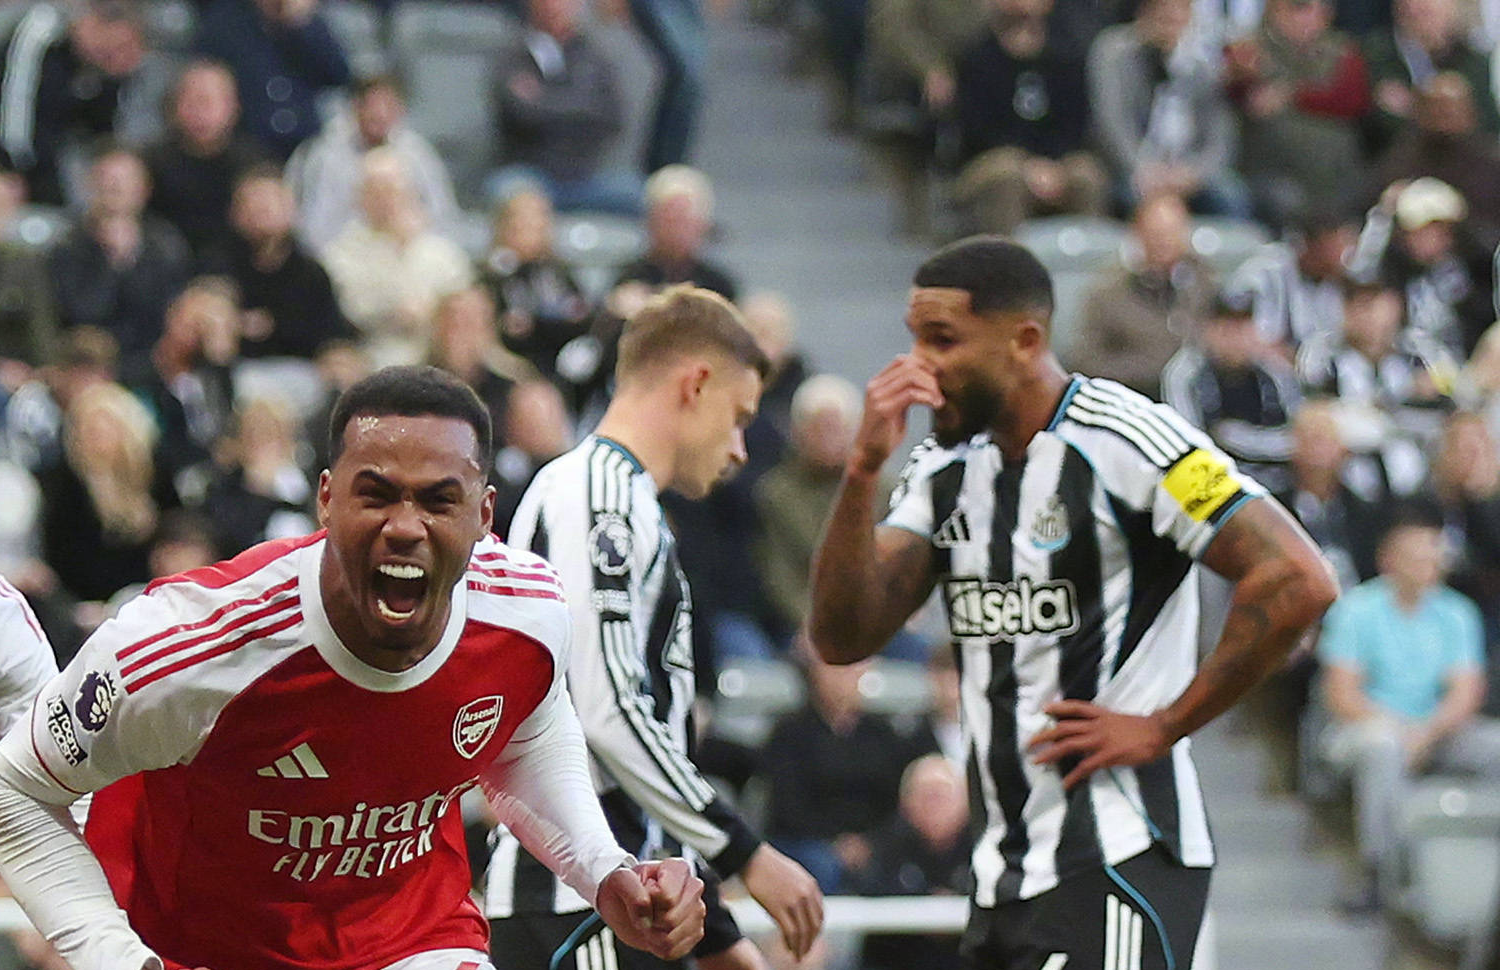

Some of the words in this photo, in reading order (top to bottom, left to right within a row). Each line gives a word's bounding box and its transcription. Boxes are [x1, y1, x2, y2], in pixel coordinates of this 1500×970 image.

[981, 577, 1072, 636] sela
[57, 712, 80, 757] room
[272, 851, 334, 883] FLY
[333, 823, 435, 878] BETTER
